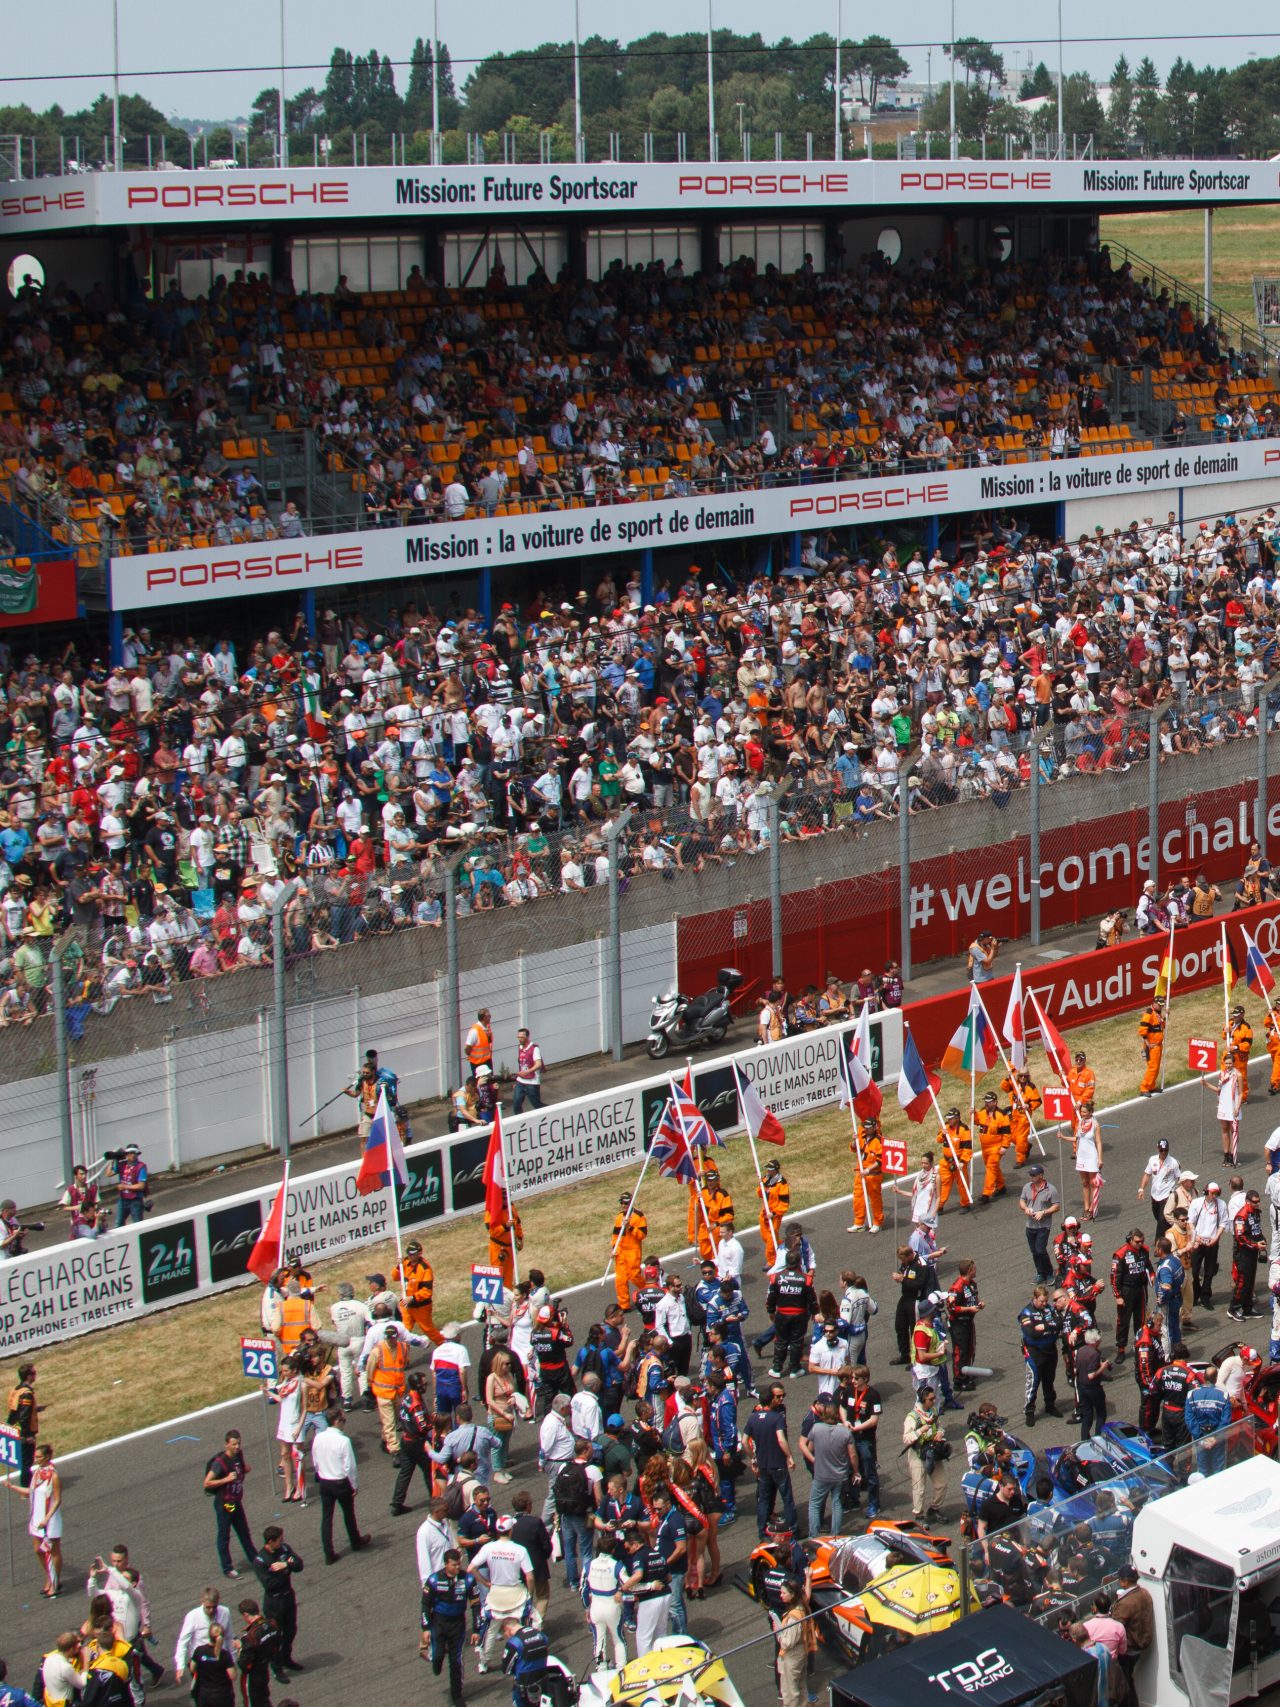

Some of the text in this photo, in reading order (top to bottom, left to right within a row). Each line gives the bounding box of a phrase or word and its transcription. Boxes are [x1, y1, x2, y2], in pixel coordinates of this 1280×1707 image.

[127, 182, 349, 209] PORSCHE
[396, 174, 638, 205] Mission: Future Sportscar
[678, 174, 849, 196] PORSCHE
[900, 171, 1052, 192] PORSCHE
[1083, 169, 1251, 194] Mission: Future Sportscar
[980, 472, 1034, 499] Mission
[1048, 467, 1062, 492] la
[1065, 463, 1111, 489] voiture
[1115, 461, 1133, 485] de
[1136, 455, 1170, 484] sport
[1174, 453, 1191, 477] de
[1193, 452, 1239, 477] demain
[789, 483, 949, 518] PORSCHE
[406, 533, 479, 564] Mission
[499, 528, 515, 554] la
[522, 523, 584, 551] voiture
[590, 518, 612, 544] de
[617, 512, 663, 544] sport
[669, 509, 690, 535] de
[695, 502, 755, 531] demain
[146, 546, 363, 592] PORSCHE
[1058, 962, 1132, 1016] Audi
[1190, 1038, 1215, 1049] MOTUL
[744, 1038, 838, 1084] DOWNLOAD
[1198, 1050, 1209, 1069] 2
[770, 1079, 782, 1097] LE
[785, 1071, 815, 1091] MANS
[818, 1066, 838, 1085] App
[1044, 1086, 1071, 1098] MOTUL
[766, 1085, 838, 1116] OBILE AND TABLET
[1053, 1099, 1063, 1118] 1
[505, 1098, 635, 1157] TÉLÉCHARGEZ
[547, 1146, 575, 1167] 24H
[579, 1137, 593, 1156] LE
[597, 1125, 637, 1151] MANS
[883, 1138, 906, 1150] MOTUL
[523, 1162, 584, 1189] SMARTPHONE
[585, 1161, 594, 1171] ET
[594, 1147, 637, 1168] TABLETTE
[885, 1151, 905, 1173] 12
[418, 1193, 439, 1207] MANS
[301, 1216, 317, 1235] LE
[319, 1206, 359, 1230] MANS
[362, 1199, 387, 1220] App
[286, 1218, 388, 1259] MOBILE AND TABLET
[148, 1236, 193, 1278] 24h
[472, 1265, 502, 1277] MOTUL
[148, 1265, 192, 1287] LE MANS
[474, 1278, 502, 1302] 47
[20, 1297, 55, 1325] 24H
[61, 1285, 79, 1312] LE
[83, 1273, 134, 1302] MANS
[69, 1316, 80, 1328] ET
[81, 1297, 134, 1323] TABLETTE
[243, 1338, 274, 1349] MOTUL
[245, 1351, 275, 1376] 26
[927, 1647, 1006, 1692] TDS
[962, 1663, 1015, 1693] RACING
